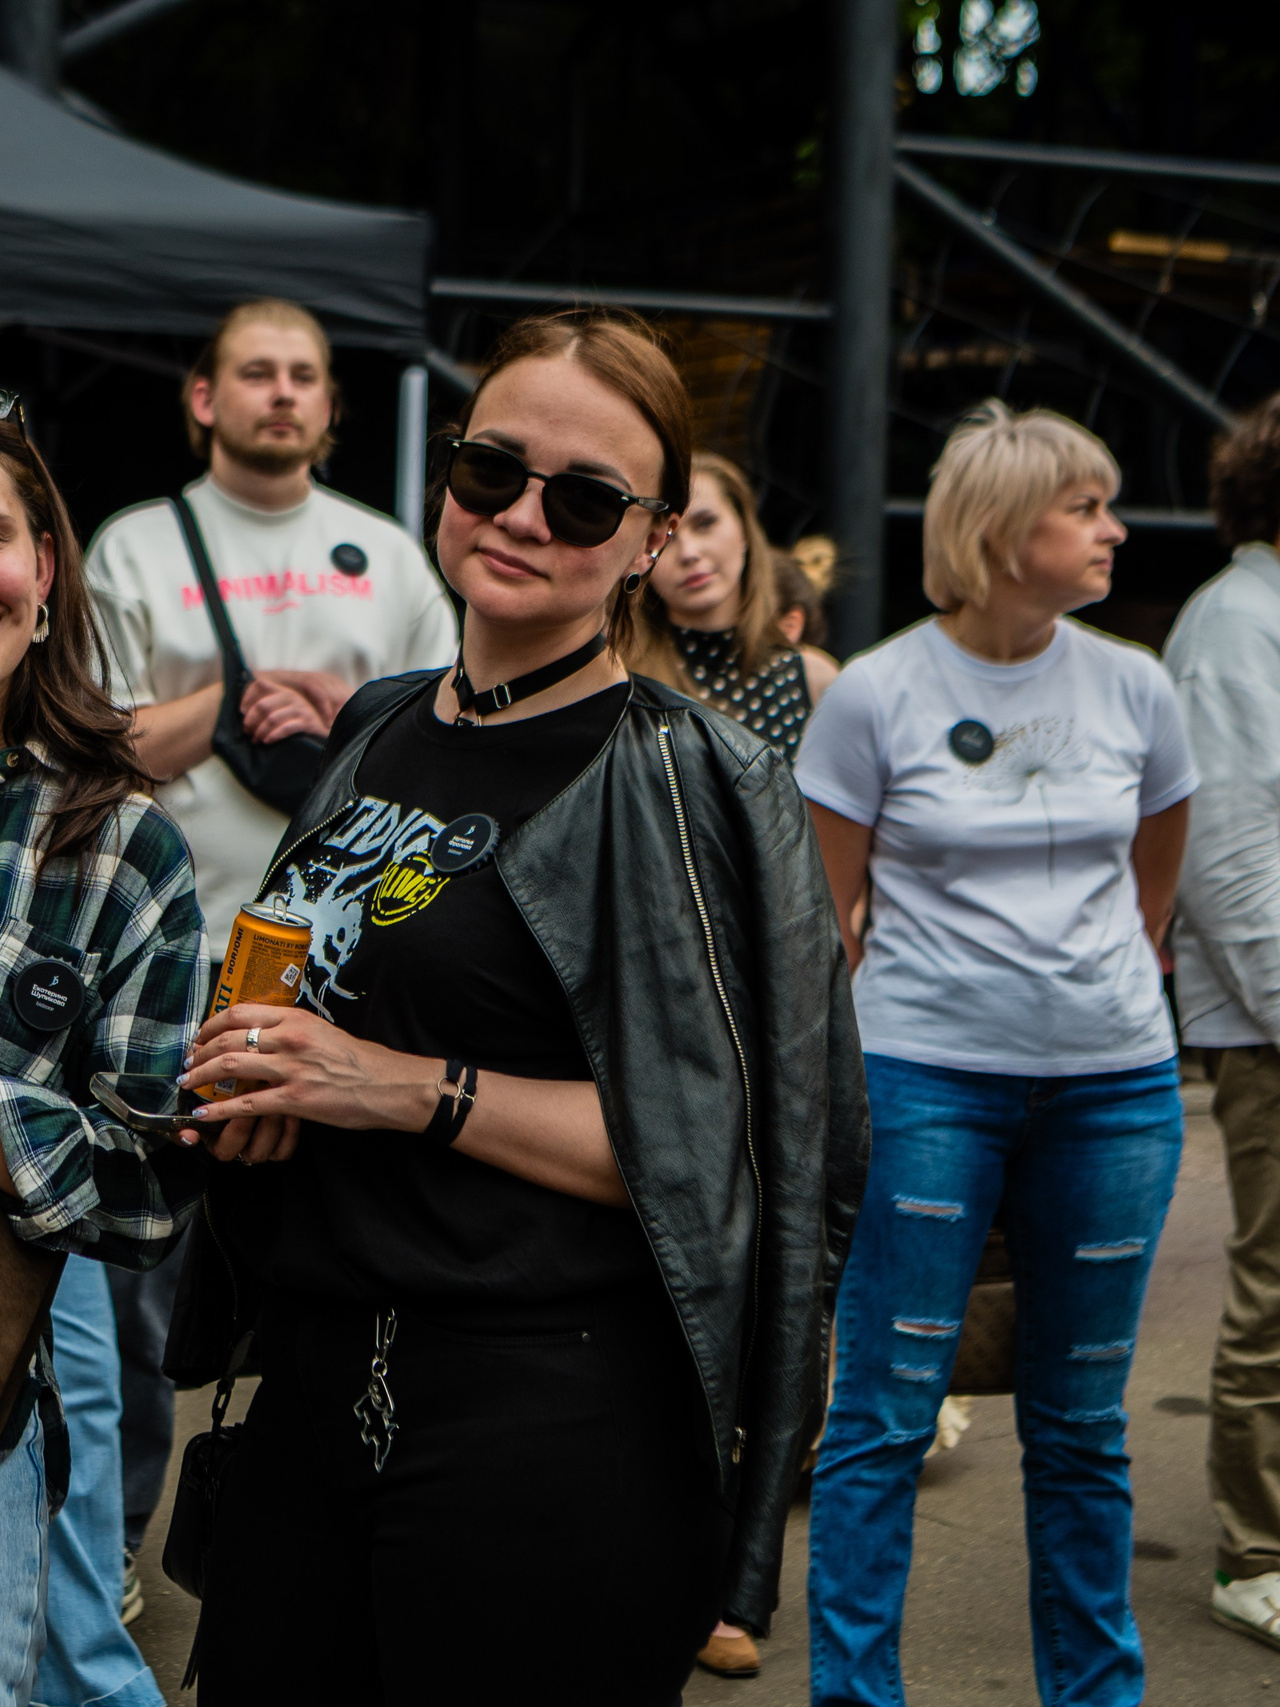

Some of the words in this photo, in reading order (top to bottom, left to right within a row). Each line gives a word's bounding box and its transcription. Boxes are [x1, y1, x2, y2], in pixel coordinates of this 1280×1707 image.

[181, 570, 373, 611] MNIMALISM
[227, 927, 244, 975] BORJOMI
[253, 934, 286, 948] LIMONATI
[32, 983, 68, 1001] Екатерина
